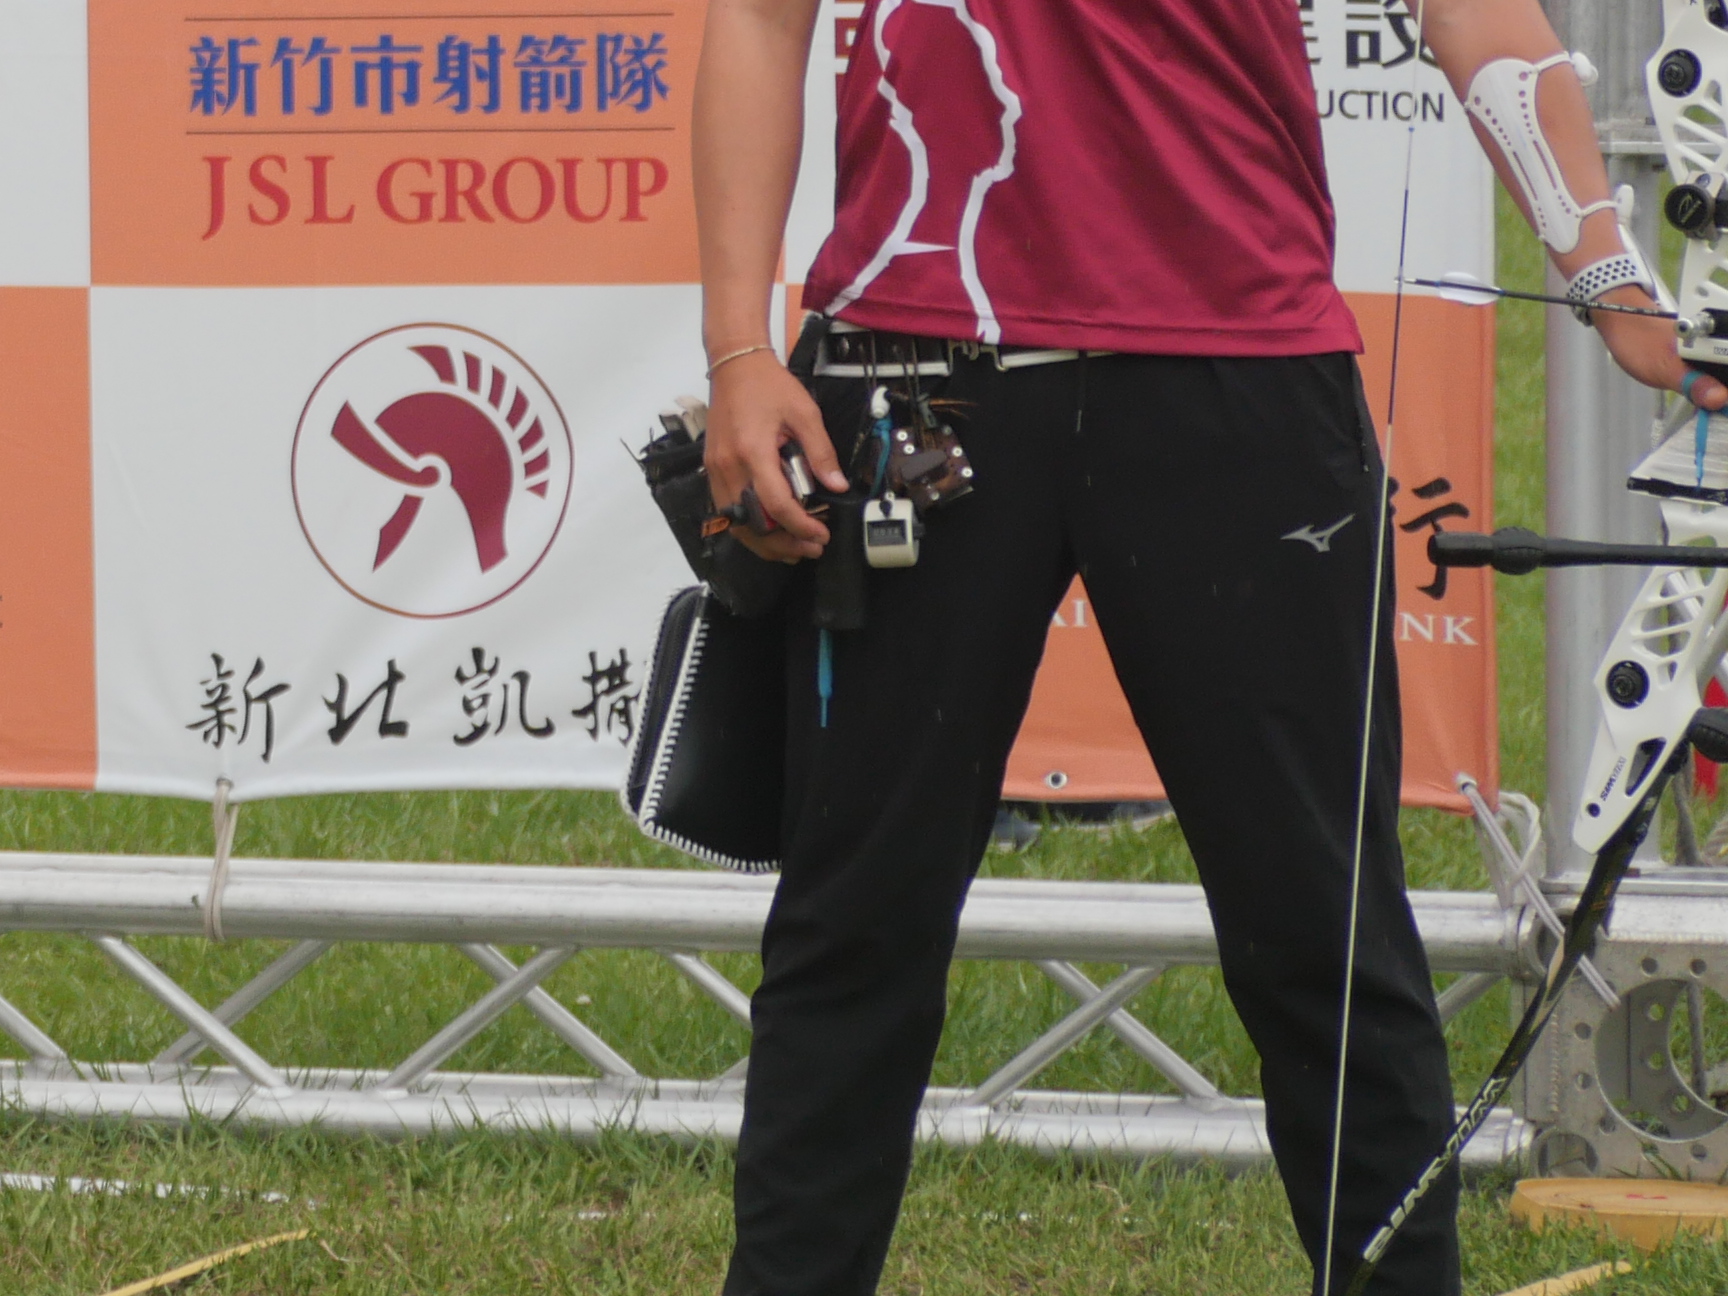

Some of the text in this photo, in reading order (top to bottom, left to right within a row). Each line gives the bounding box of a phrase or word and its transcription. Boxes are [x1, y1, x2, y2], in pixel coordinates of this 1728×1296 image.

[189, 33, 671, 116] 新竹市射箭隊
[201, 154, 670, 242] JSL GROUP
